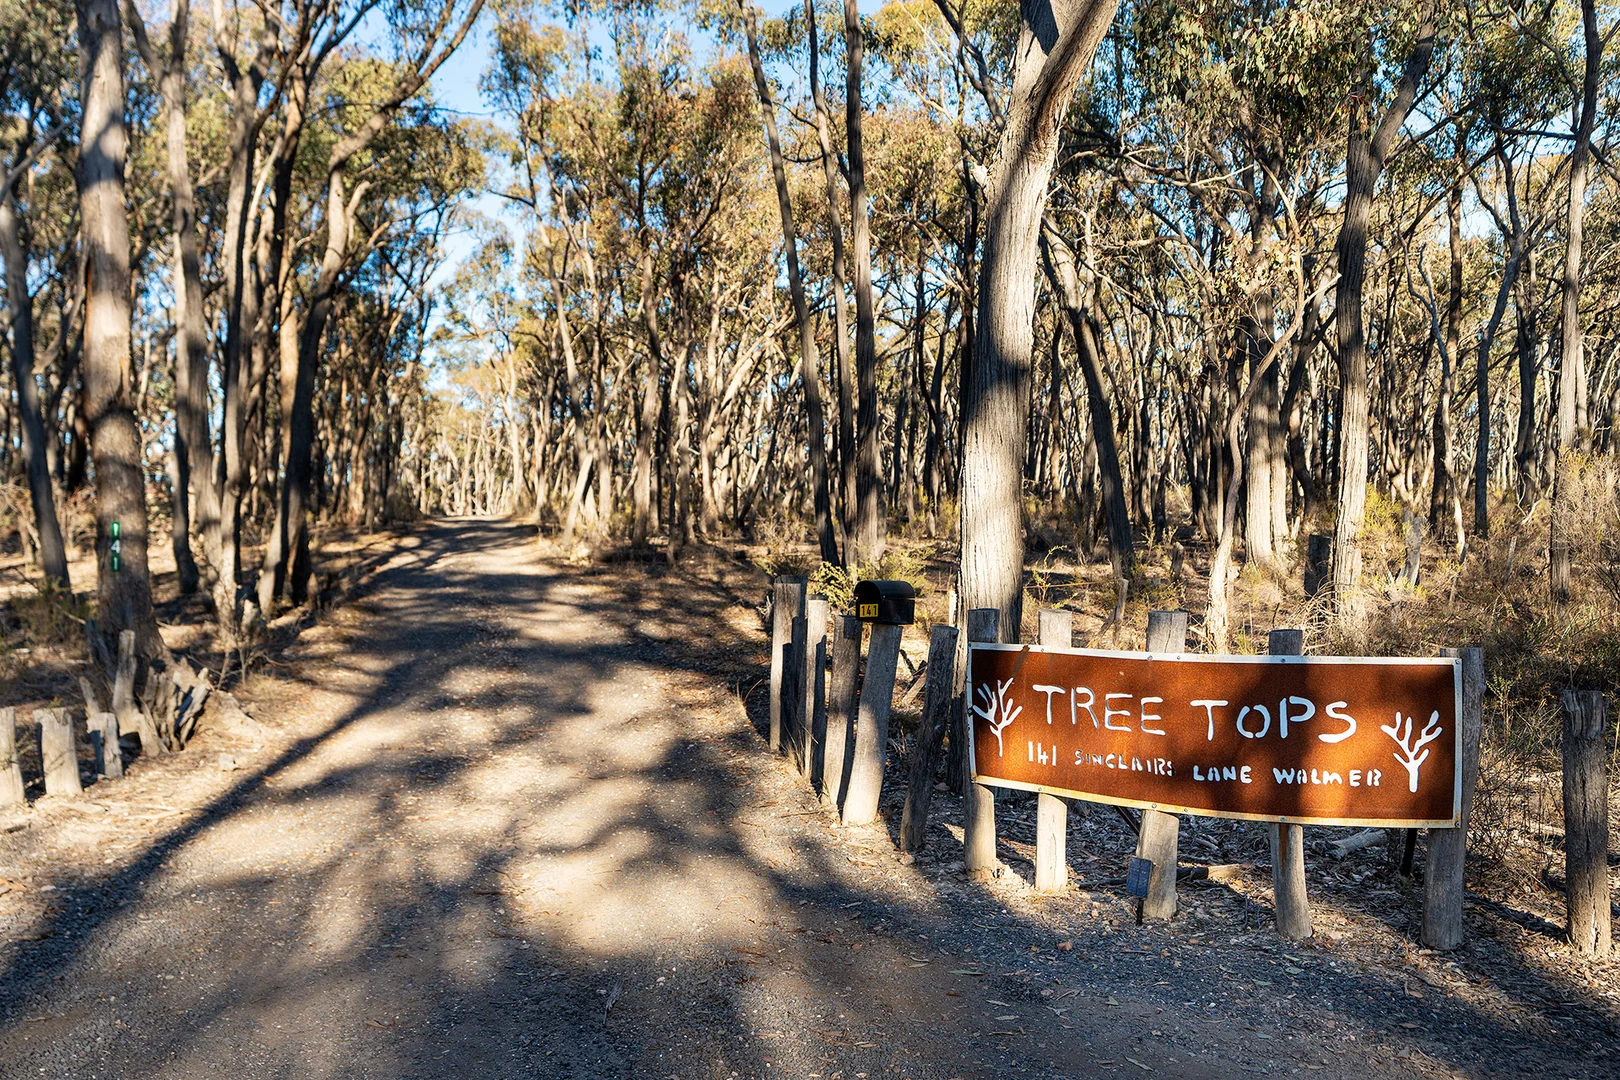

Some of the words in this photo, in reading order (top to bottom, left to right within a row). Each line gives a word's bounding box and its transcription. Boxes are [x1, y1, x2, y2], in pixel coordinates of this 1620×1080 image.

[861, 605, 877, 616] 141
[1032, 684, 1166, 736] TREE
[1190, 695, 1357, 744] TOPS
[1027, 740, 1057, 767] 141
[1074, 749, 1175, 777] SINCLAIRS
[1193, 764, 1253, 784] LANE
[1272, 767, 1382, 787] WALMER
